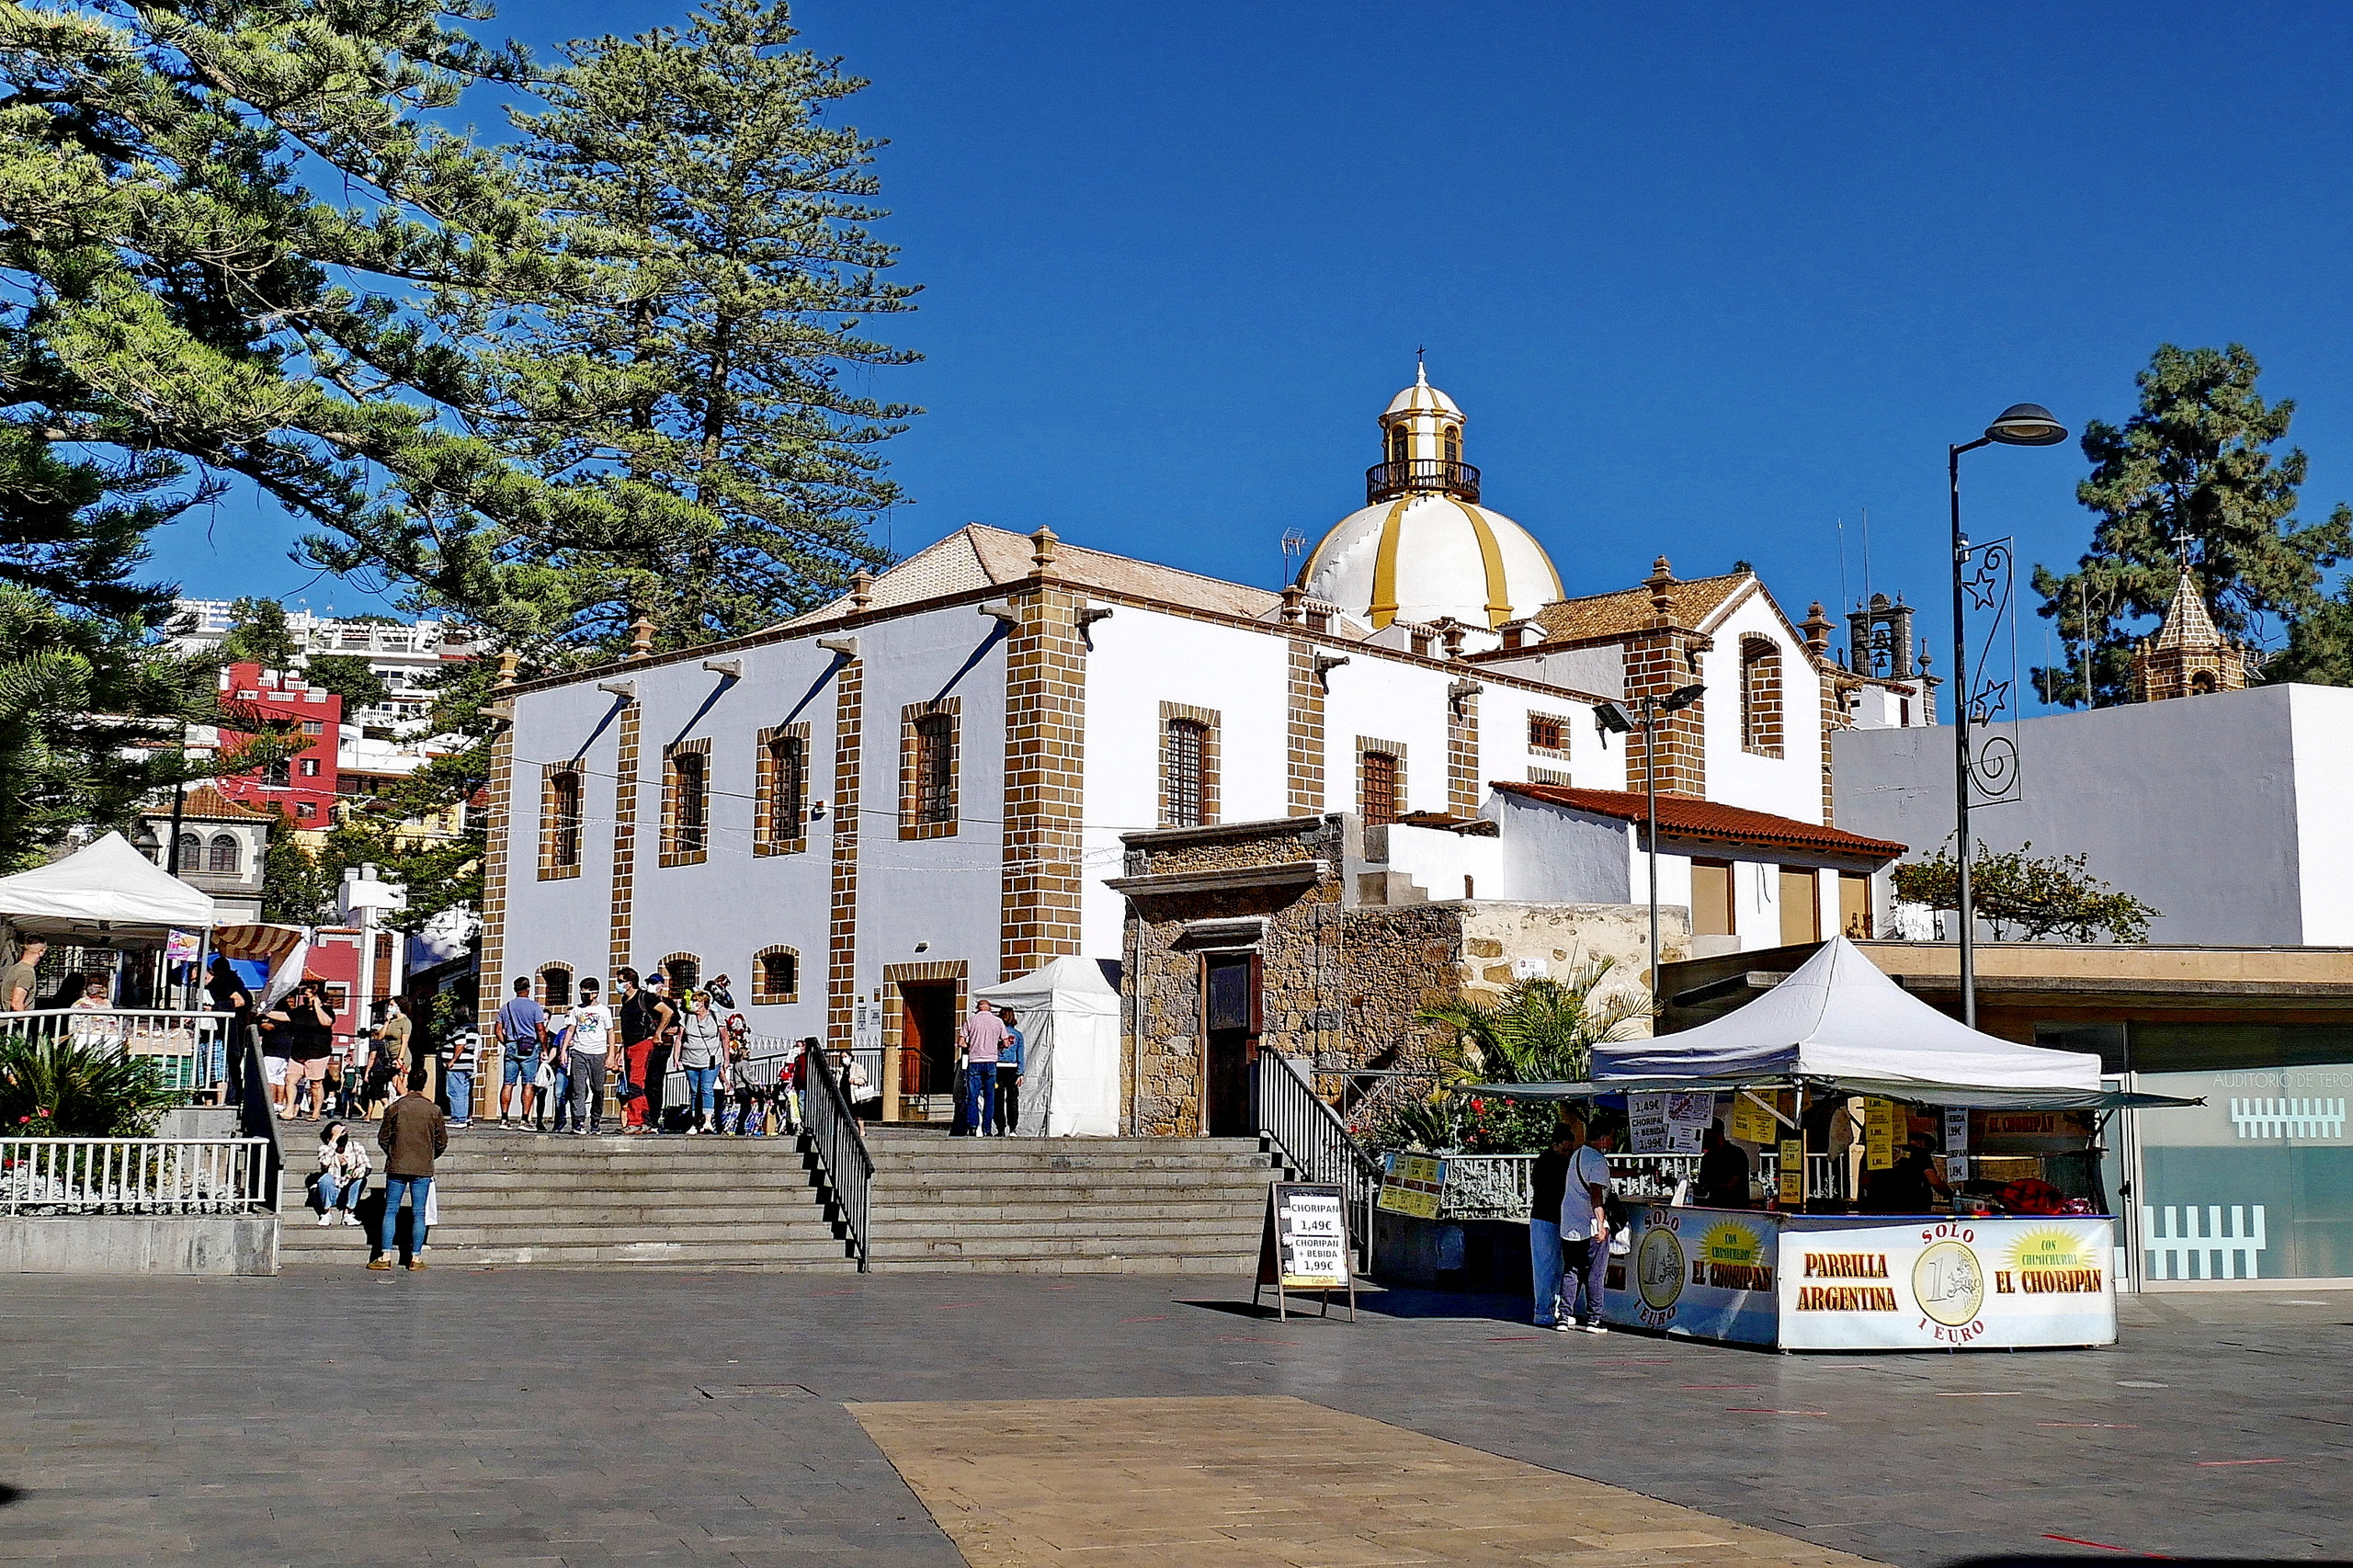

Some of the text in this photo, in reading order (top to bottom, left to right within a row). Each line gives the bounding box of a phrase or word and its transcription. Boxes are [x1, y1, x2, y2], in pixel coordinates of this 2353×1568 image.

[2212, 1073, 2292, 1088] AUDITORIO
[2297, 1073, 2313, 1088] DE
[1635, 1099, 1660, 1113] 1,49€
[1642, 1126, 1665, 1137] BEBIDA
[1639, 1138, 1663, 1150] 1,99€
[1291, 1204, 1339, 1213] CHORIPAN
[1301, 1221, 1332, 1232] 1,49€
[1643, 1210, 1680, 1232] SOLO
[1921, 1222, 1975, 1245] SOLO
[2040, 1240, 2057, 1251] CON
[1303, 1261, 1334, 1271] 1,99€
[1803, 1253, 1890, 1278] PARRILLA
[2021, 1254, 2078, 1266] CHIMICHURRI
[1692, 1260, 1706, 1285] EL
[1710, 1262, 1772, 1292] CHORIPAN
[1995, 1269, 2103, 1294] EL CHORIPAN
[1796, 1285, 1899, 1312] ARGENTINA
[1639, 1305, 1677, 1325] EURO
[1934, 1320, 1984, 1344] EURO
